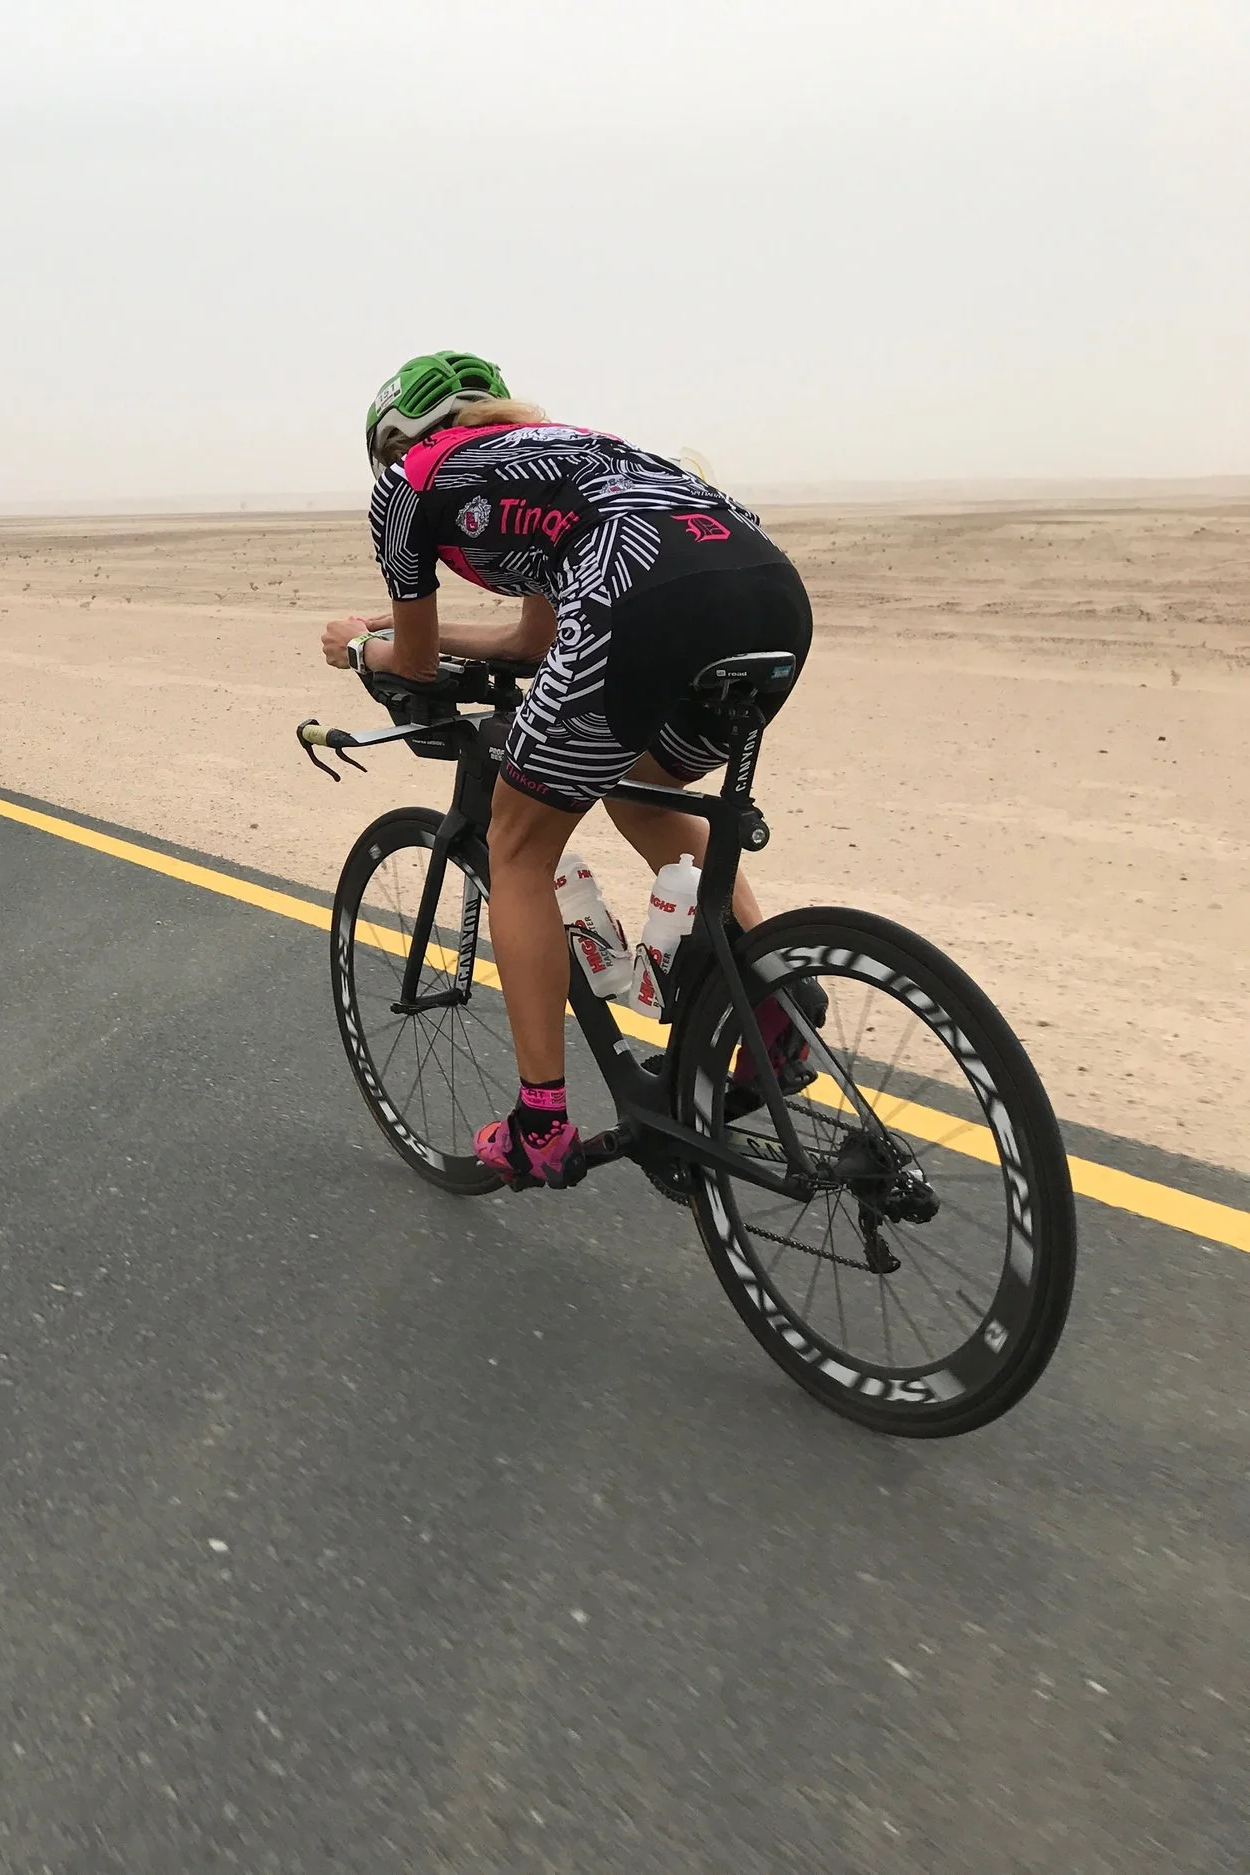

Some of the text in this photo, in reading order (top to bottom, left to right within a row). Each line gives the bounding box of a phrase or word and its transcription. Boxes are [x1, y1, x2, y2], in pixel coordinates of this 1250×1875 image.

[489, 746, 505, 755] PROF
[735, 729, 759, 792] CANYON
[505, 760, 550, 795] Tinkoff
[458, 899, 478, 982] CANYON
